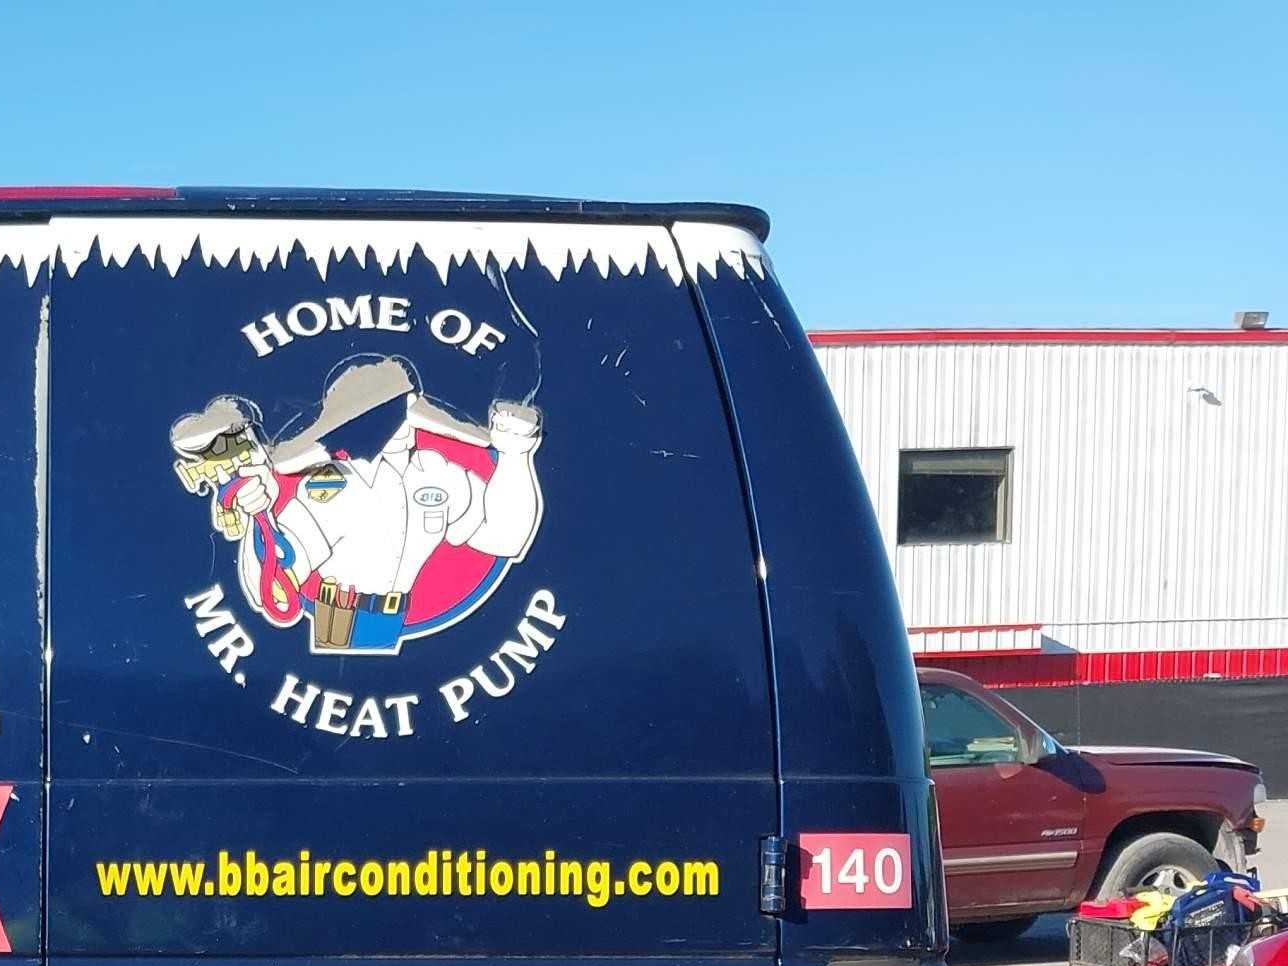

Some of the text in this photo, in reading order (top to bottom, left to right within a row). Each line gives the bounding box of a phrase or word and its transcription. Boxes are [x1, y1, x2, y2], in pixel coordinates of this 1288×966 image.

[241, 295, 505, 357] HOME OF
[184, 584, 567, 738] MR. HEAT PUMP
[96, 850, 720, 908] www.bbairconditioning.com
[810, 846, 904, 895] 140
